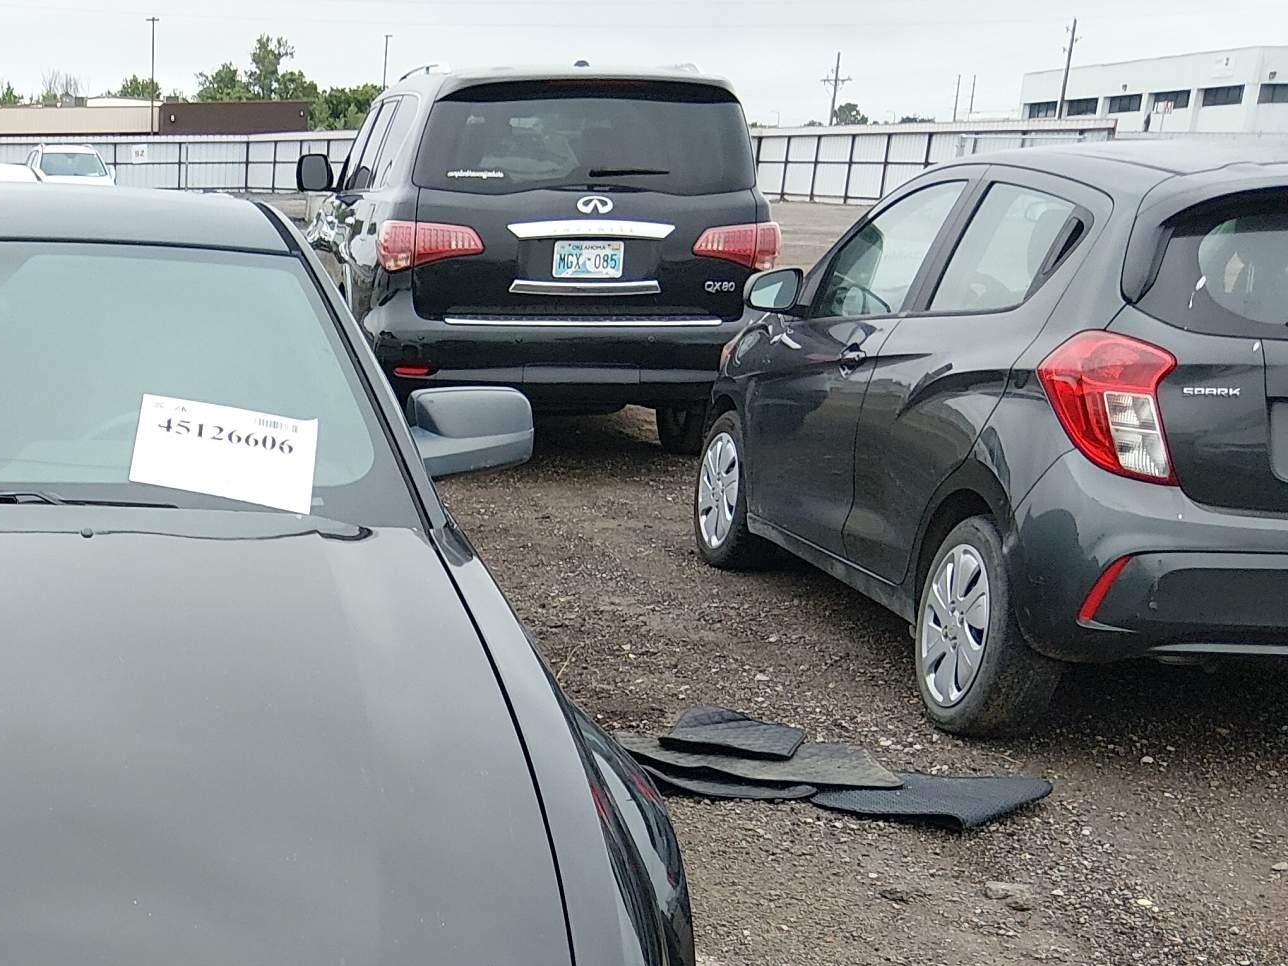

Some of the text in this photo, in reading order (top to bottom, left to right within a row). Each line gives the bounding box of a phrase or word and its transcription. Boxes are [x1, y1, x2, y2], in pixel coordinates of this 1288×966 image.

[704, 281, 736, 293] QX80
[1182, 387, 1241, 397] SPARK
[157, 417, 295, 454] 45126606
